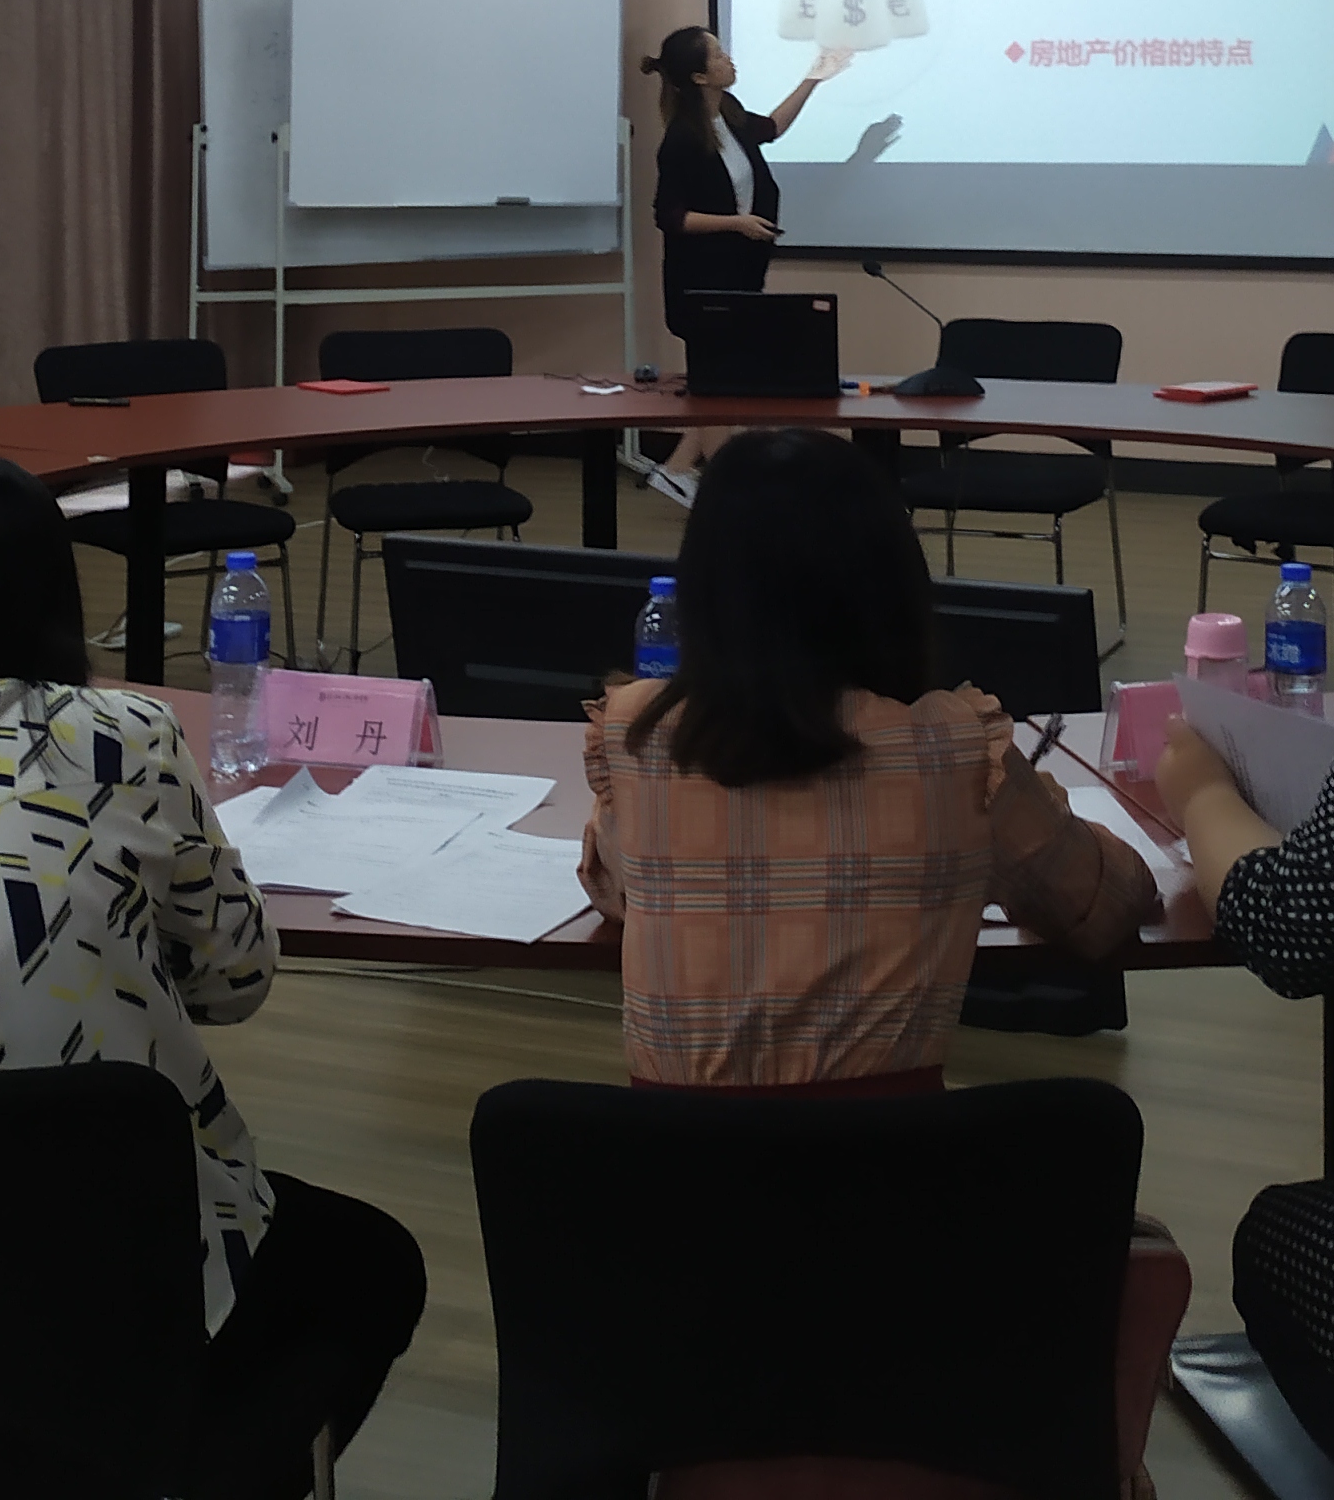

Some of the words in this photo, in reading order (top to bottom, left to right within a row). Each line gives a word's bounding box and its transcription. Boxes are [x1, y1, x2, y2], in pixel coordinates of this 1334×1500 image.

[1029, 39, 1254, 67] 房地产价格的特点
